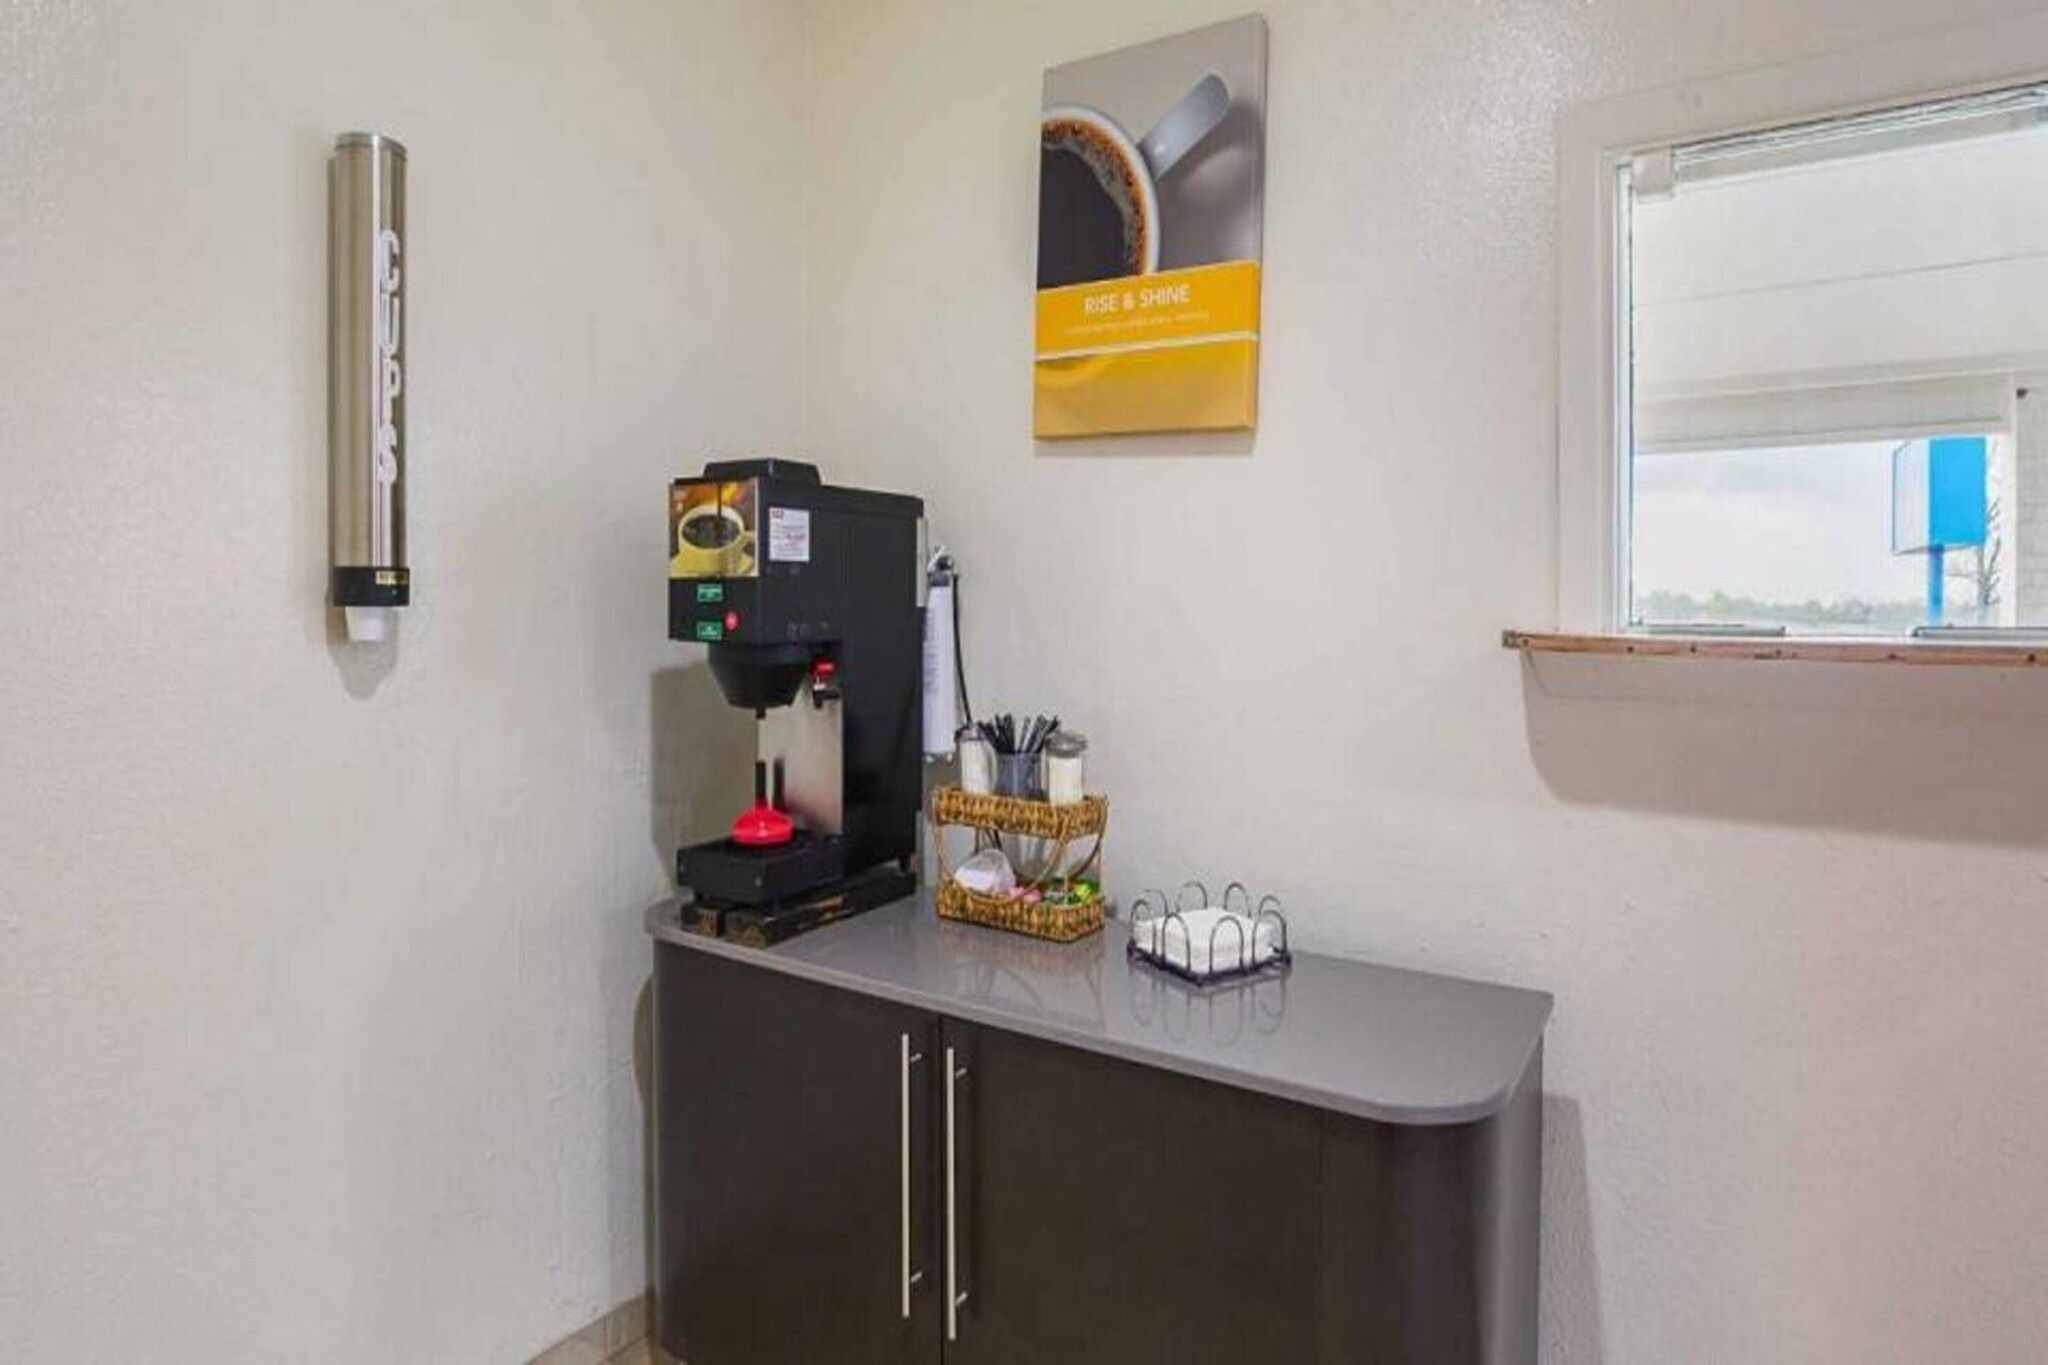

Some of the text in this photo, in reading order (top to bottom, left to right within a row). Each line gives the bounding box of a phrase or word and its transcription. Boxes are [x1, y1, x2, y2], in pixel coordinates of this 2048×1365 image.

[378, 229, 401, 486] CUPS
[1085, 285, 1191, 314] RISE & SHINE
